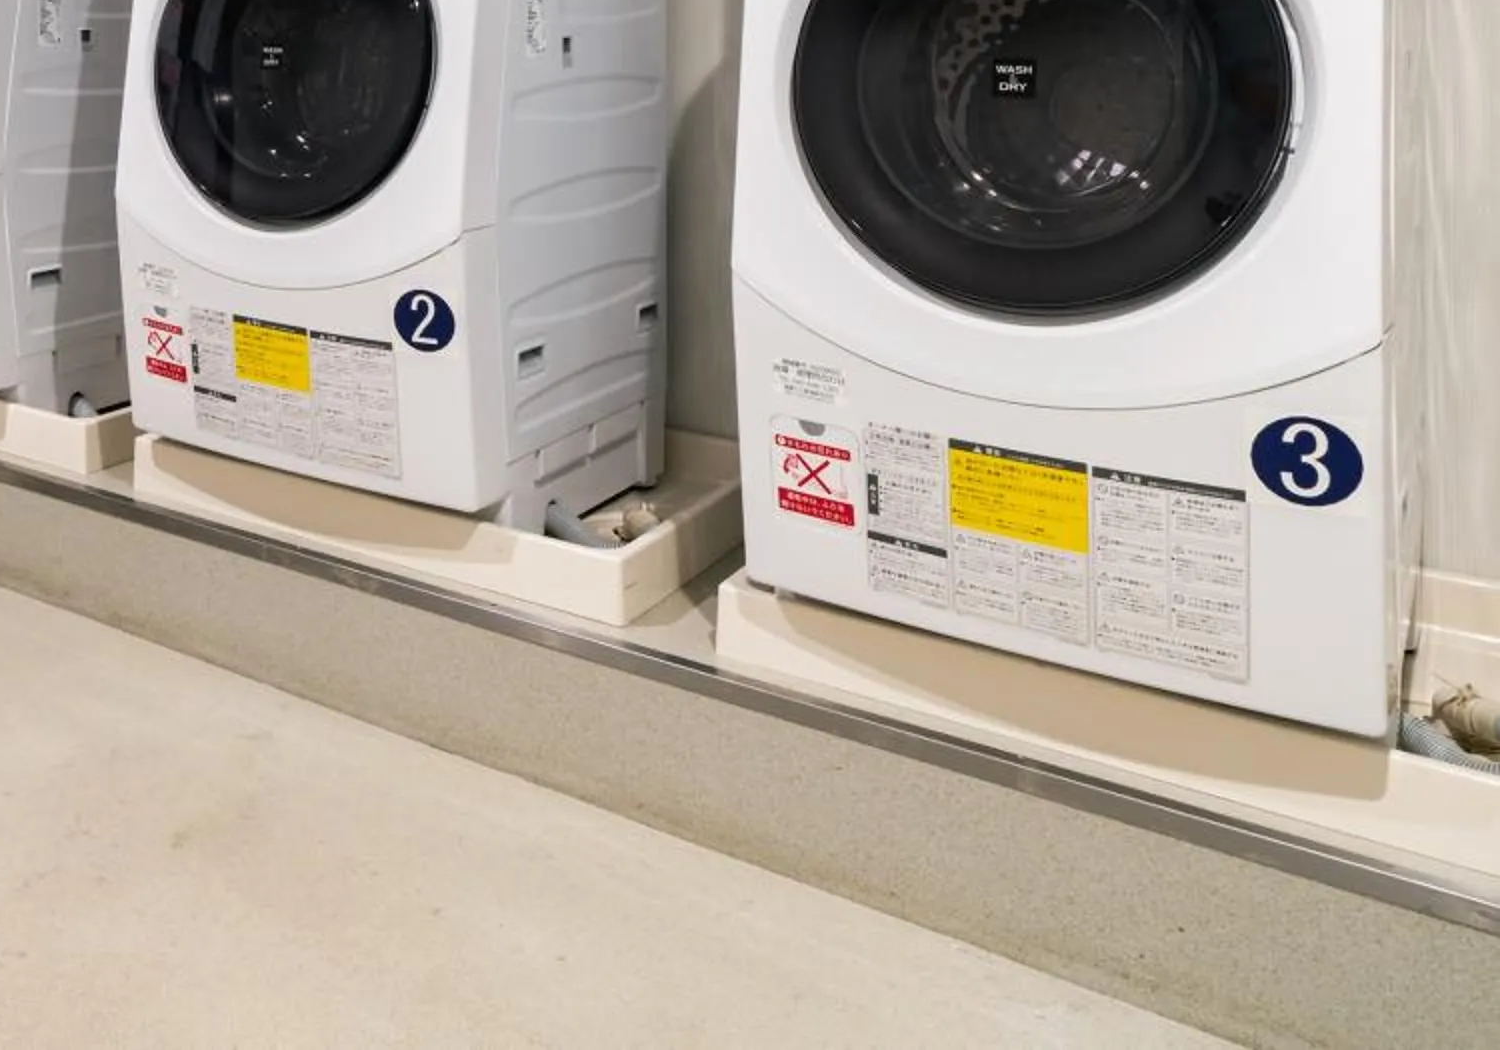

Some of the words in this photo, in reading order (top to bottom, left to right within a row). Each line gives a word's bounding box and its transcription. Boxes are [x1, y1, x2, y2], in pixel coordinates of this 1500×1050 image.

[995, 64, 1033, 75] WASH
[999, 81, 1028, 92] DRY
[410, 294, 439, 345] 2
[1279, 422, 1332, 498] 3
